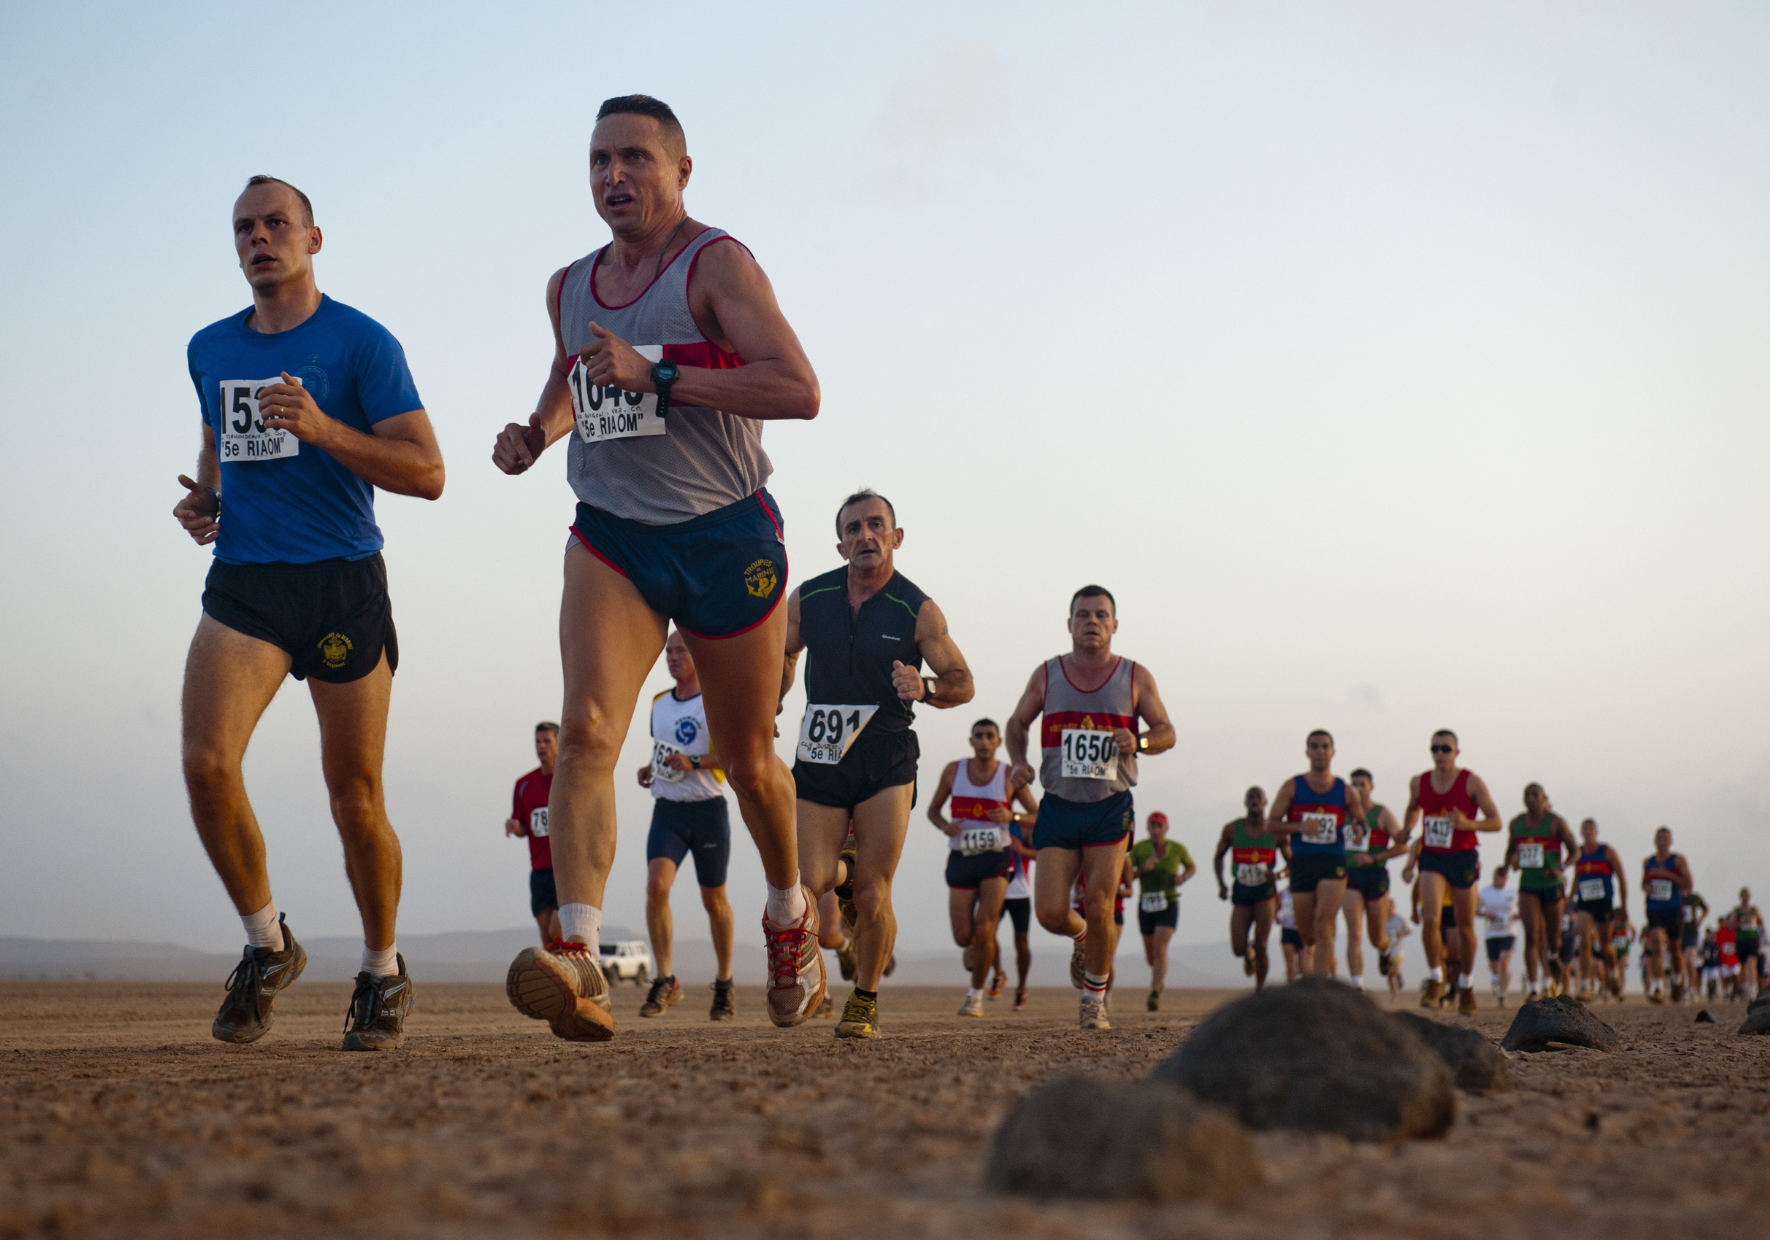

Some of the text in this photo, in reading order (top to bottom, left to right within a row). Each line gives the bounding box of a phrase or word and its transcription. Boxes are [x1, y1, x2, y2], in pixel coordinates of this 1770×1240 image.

[808, 709, 860, 745] 691
[1063, 733, 1113, 763] 1650
[964, 831, 995, 851] 1159
